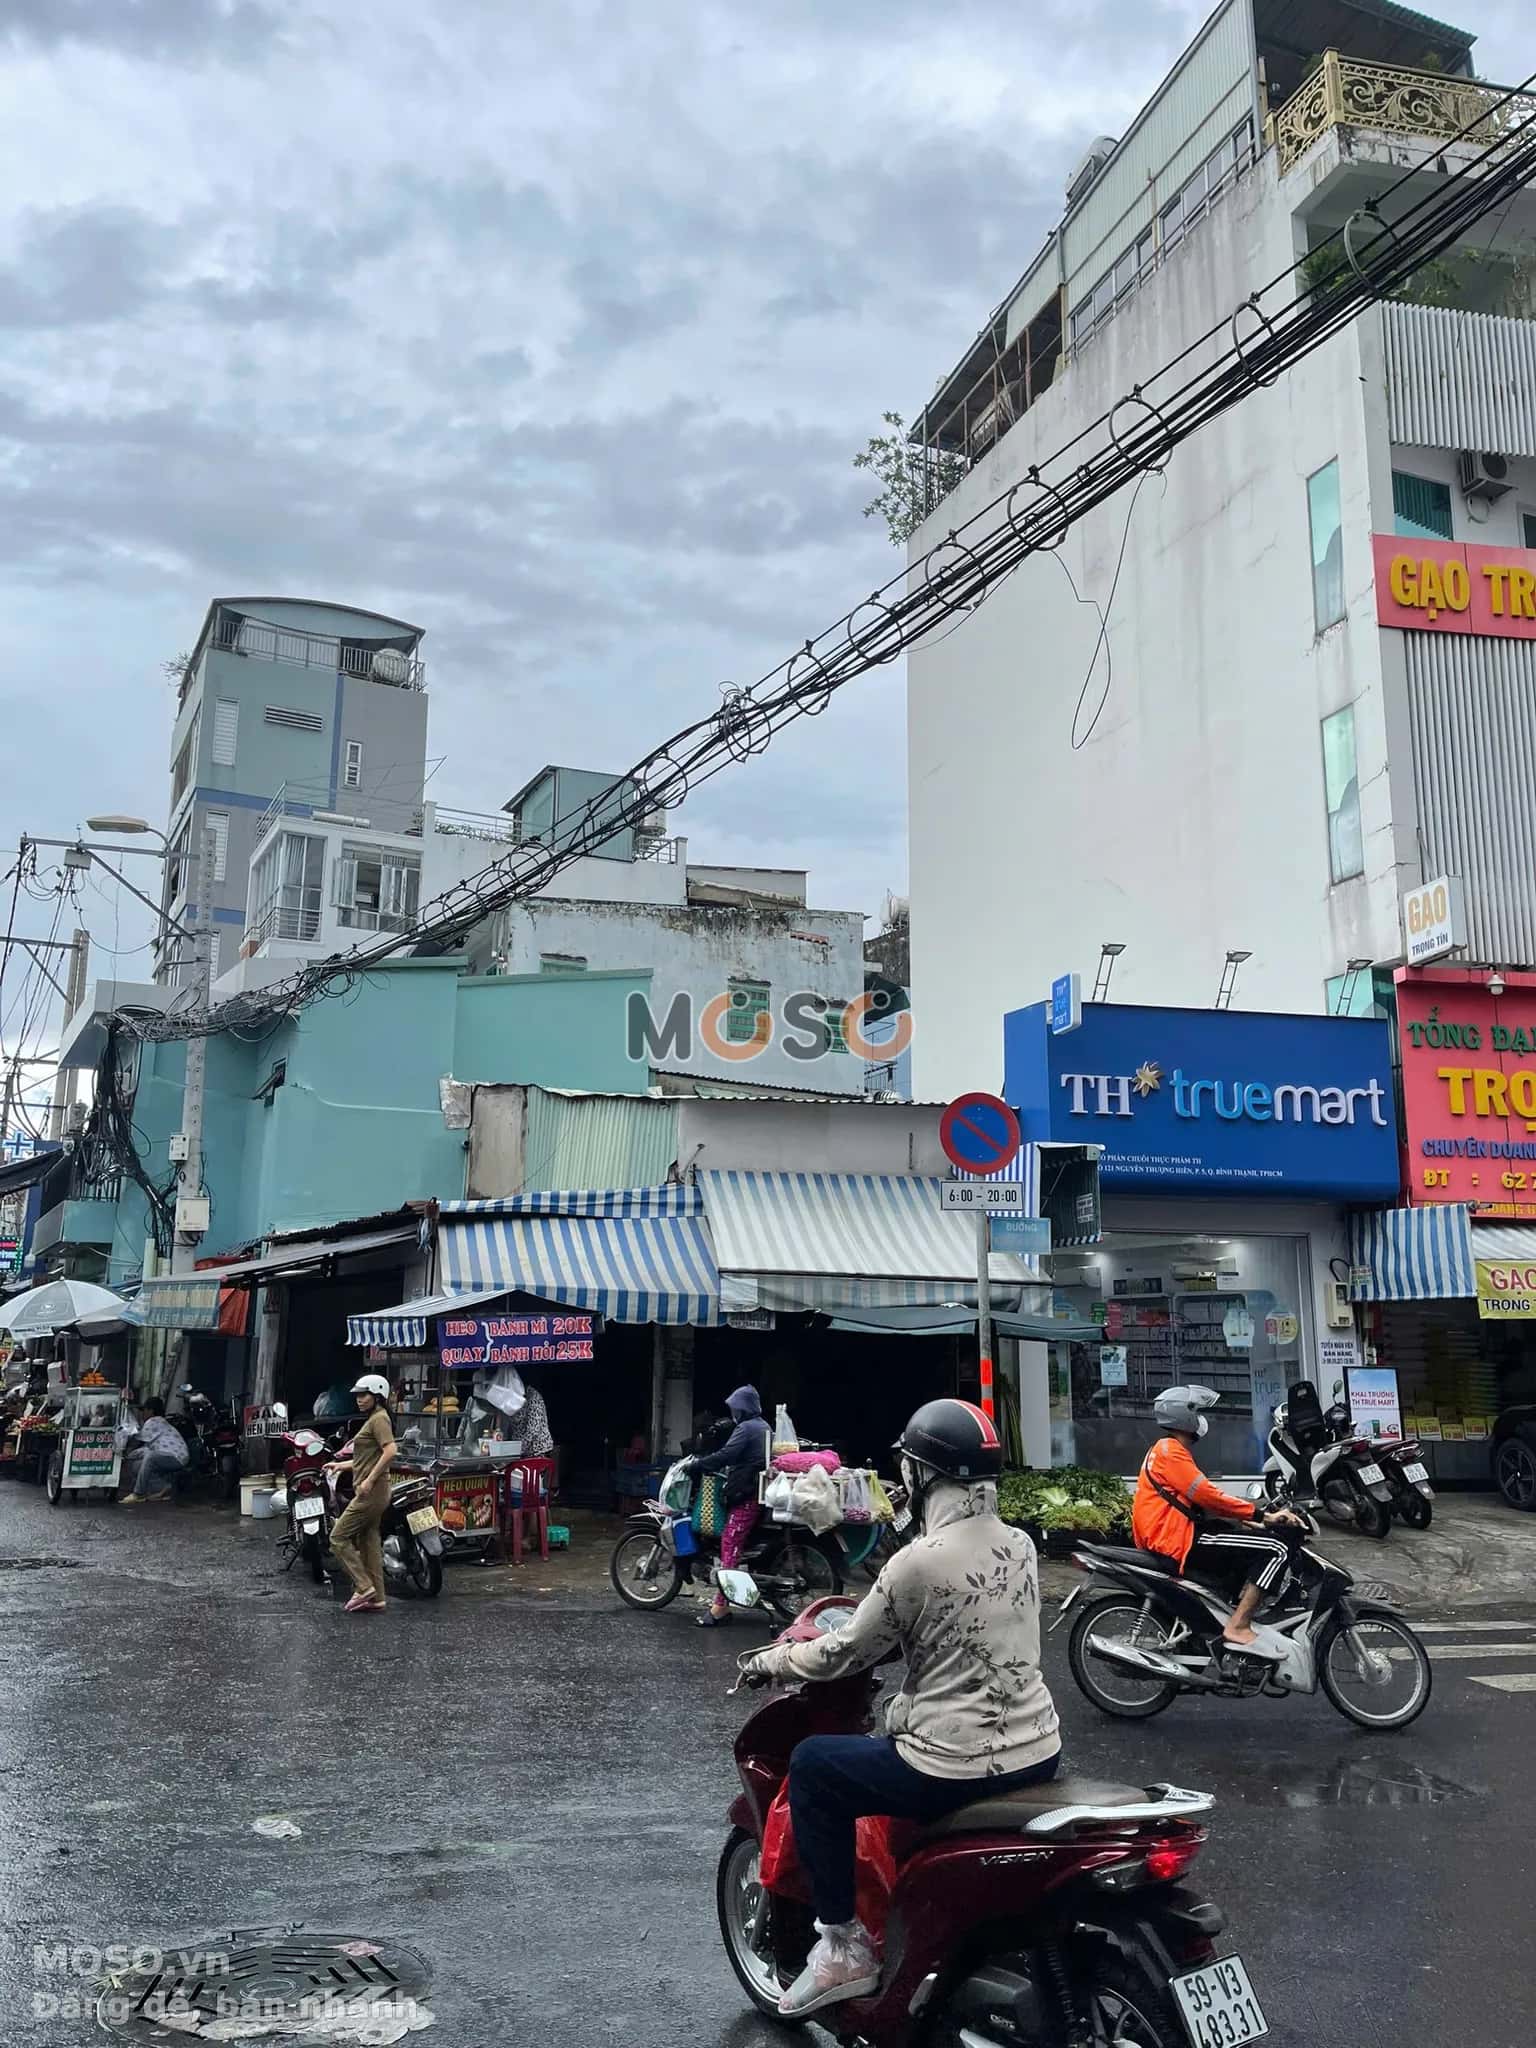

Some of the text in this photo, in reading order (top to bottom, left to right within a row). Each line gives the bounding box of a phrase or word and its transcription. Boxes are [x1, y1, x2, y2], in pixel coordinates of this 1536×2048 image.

[1391, 555, 1536, 621] GẠO TR
[1408, 1006, 1482, 1049] TỔNG
[1061, 1069, 1388, 1126] TH truemart
[1422, 1136, 1487, 1158] CHUYÊN
[1424, 1168, 1450, 1188] ĐT
[1501, 1172, 1527, 1190] 62
[949, 1189, 972, 1202] 6:00
[987, 1189, 1017, 1202] 20:00
[1482, 1299, 1530, 1313] TRỌNG
[446, 1321, 478, 1337] HEO
[489, 1316, 592, 1337] BÁNH MÌ 20K
[441, 1347, 484, 1367] QUAY
[490, 1343, 529, 1364] BÁNH
[556, 1340, 593, 1360] 25K
[980, 1851, 1055, 1866] VISION
[1184, 1963, 1242, 2012] 59-V3
